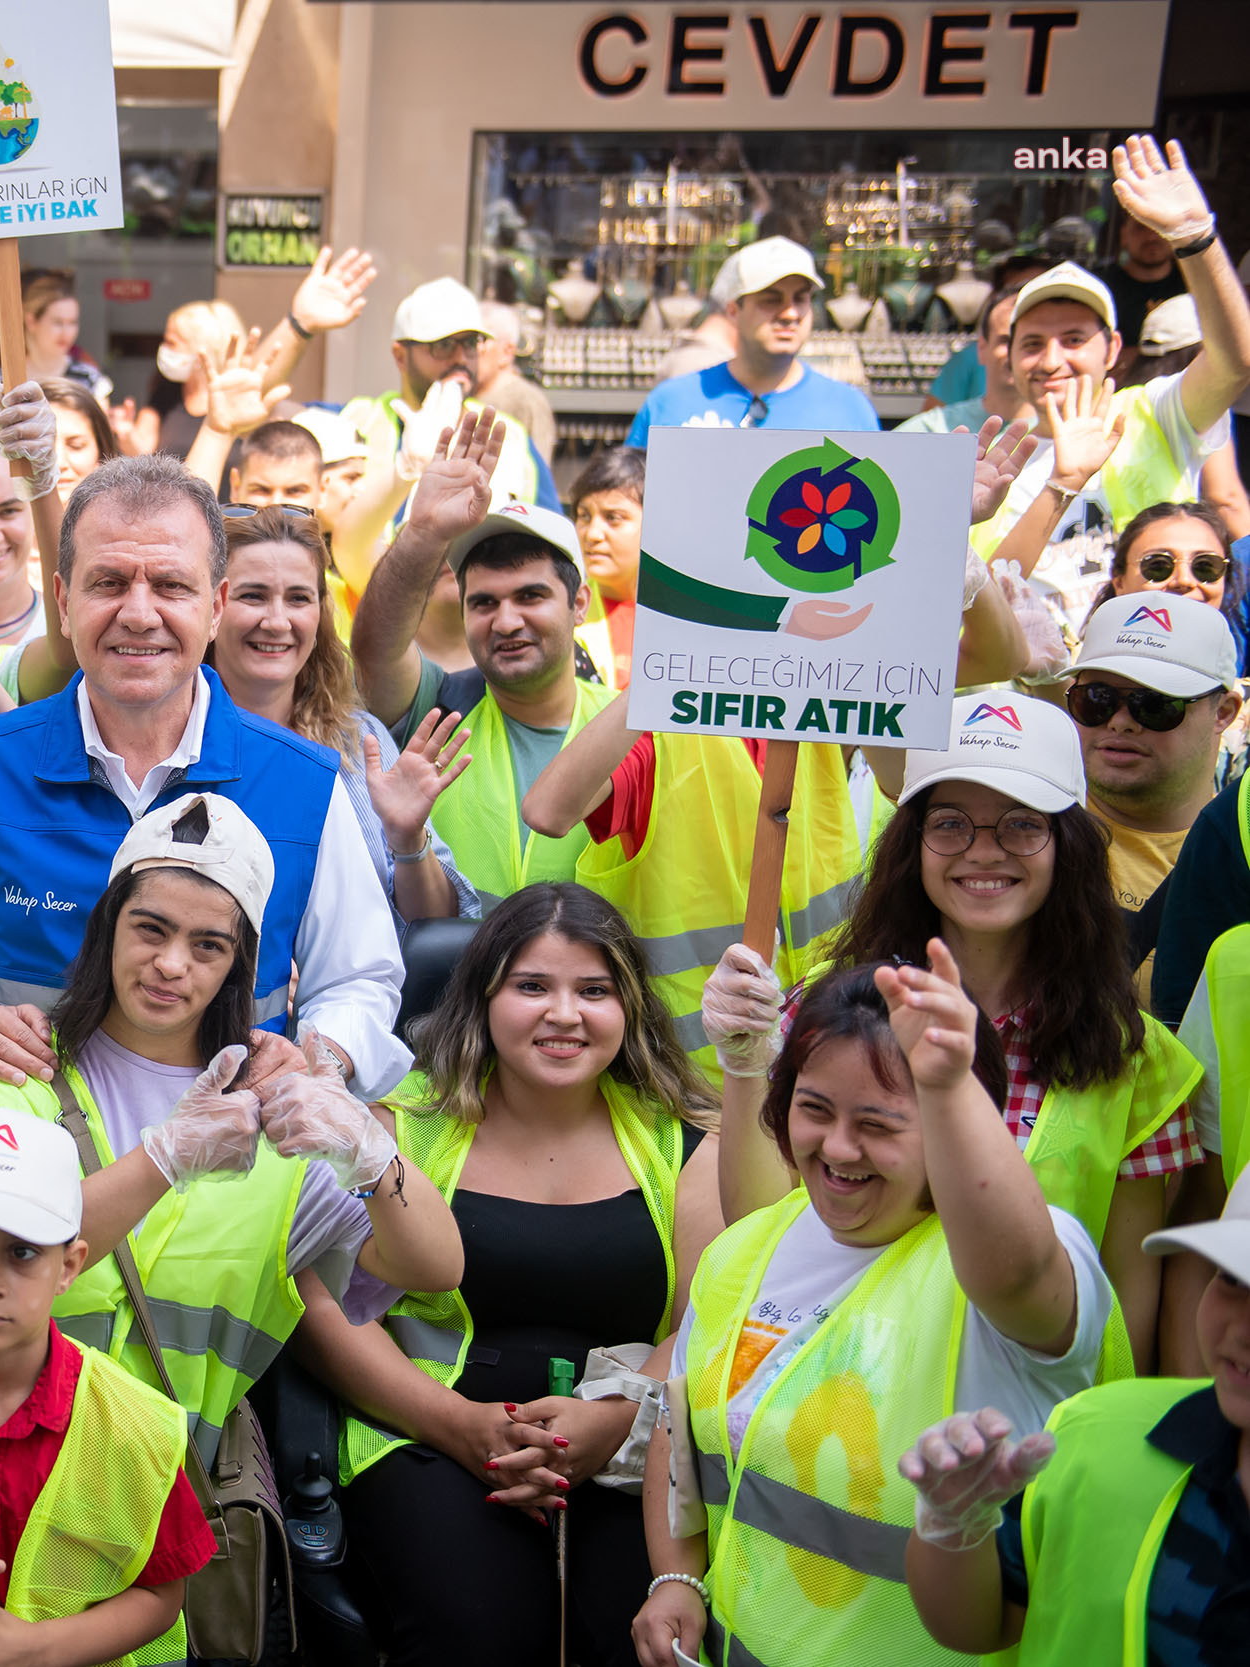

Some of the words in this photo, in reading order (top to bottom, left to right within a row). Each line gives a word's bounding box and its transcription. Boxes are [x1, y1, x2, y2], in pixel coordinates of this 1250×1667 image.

[579, 12, 1078, 98] CEVDET
[51, 198, 98, 221] BAK
[643, 652, 864, 693] GELECEĞİMİZ
[876, 660, 941, 698] İÇİN
[669, 690, 787, 730] SIFIR
[794, 697, 907, 738] ATIK
[959, 734, 992, 750] Vahap
[3, 885, 38, 916] Vahap
[41, 890, 78, 912] Secer
